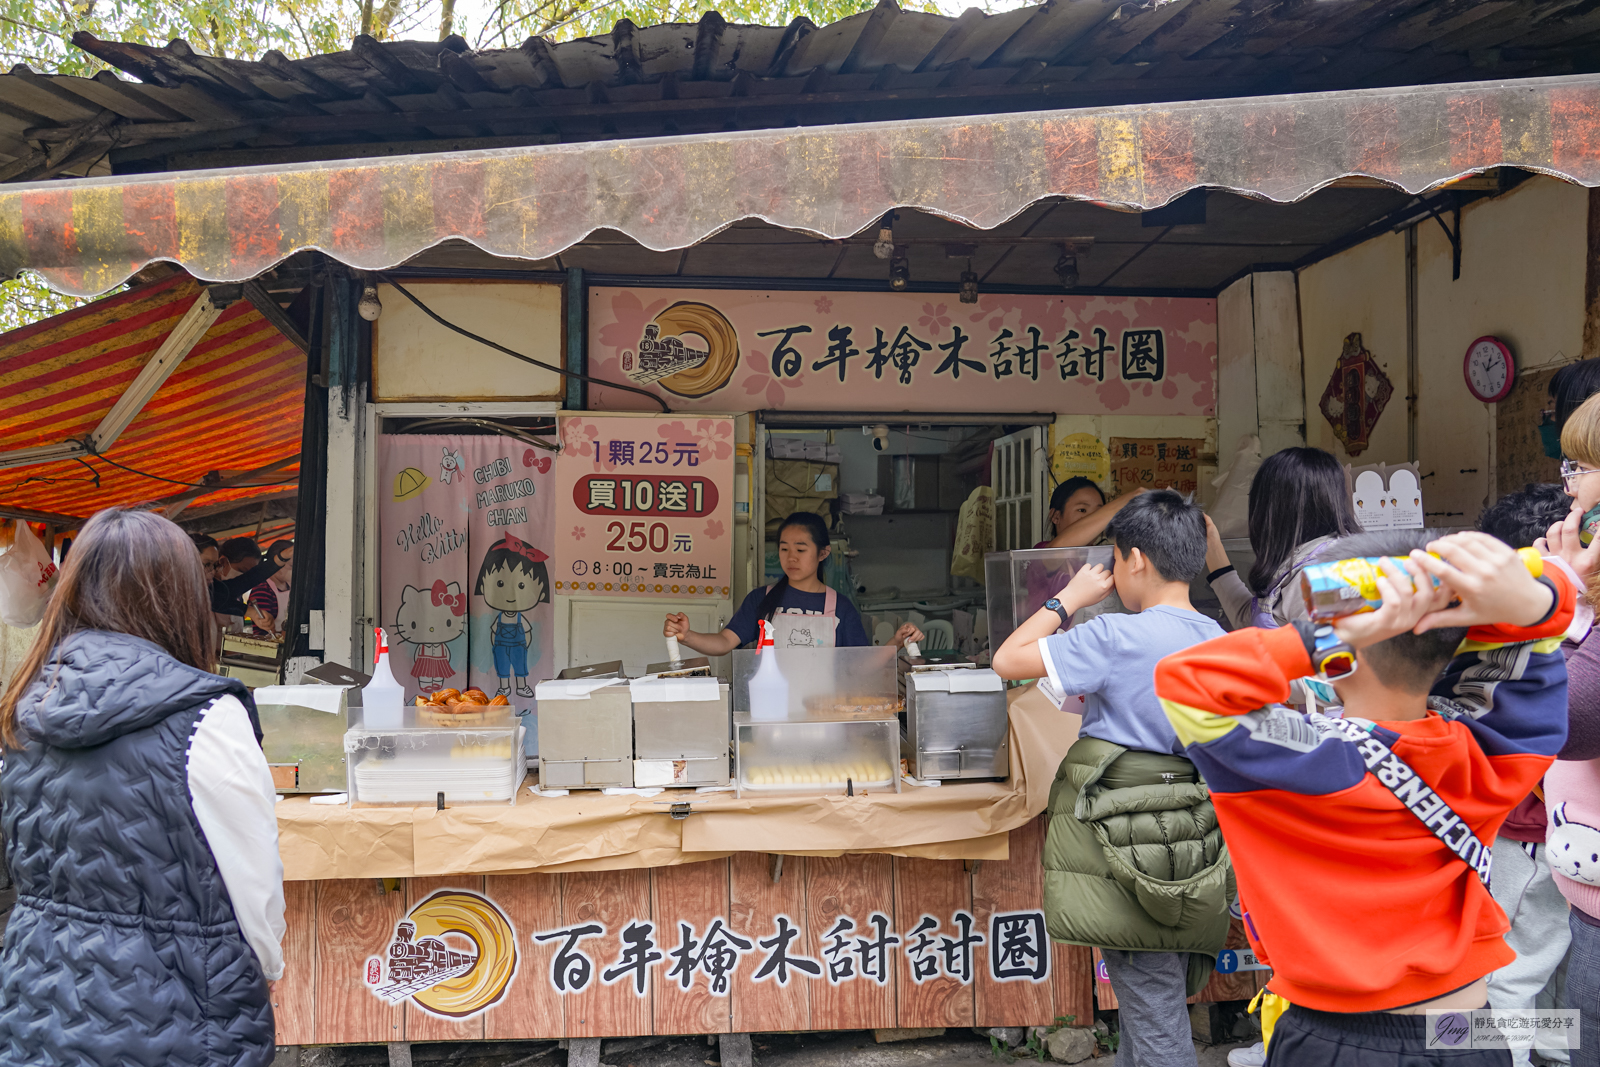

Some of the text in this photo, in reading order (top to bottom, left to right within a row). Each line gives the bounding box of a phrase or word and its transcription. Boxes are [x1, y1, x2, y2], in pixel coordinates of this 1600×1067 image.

[641, 342, 650, 350] 18
[757, 325, 1164, 385] 百年檜木甜甜圈
[593, 440, 700, 466] 1顆25元
[474, 457, 513, 485] CHIBI
[1111, 469, 1119, 482] 1
[1120, 467, 1141, 486] FOR
[1158, 462, 1194, 474] BUY 10
[476, 478, 536, 509] MARUKO
[587, 479, 704, 512] 買10送1
[1154, 480, 1174, 490] GET
[1180, 480, 1197, 492] FREE
[487, 507, 528, 527] CHAN
[396, 512, 443, 552] Hello
[420, 528, 467, 564] Kitty
[606, 521, 692, 553] 250元
[392, 945, 403, 955] 18
[535, 912, 1048, 994] 百年檜木甜甜圈
